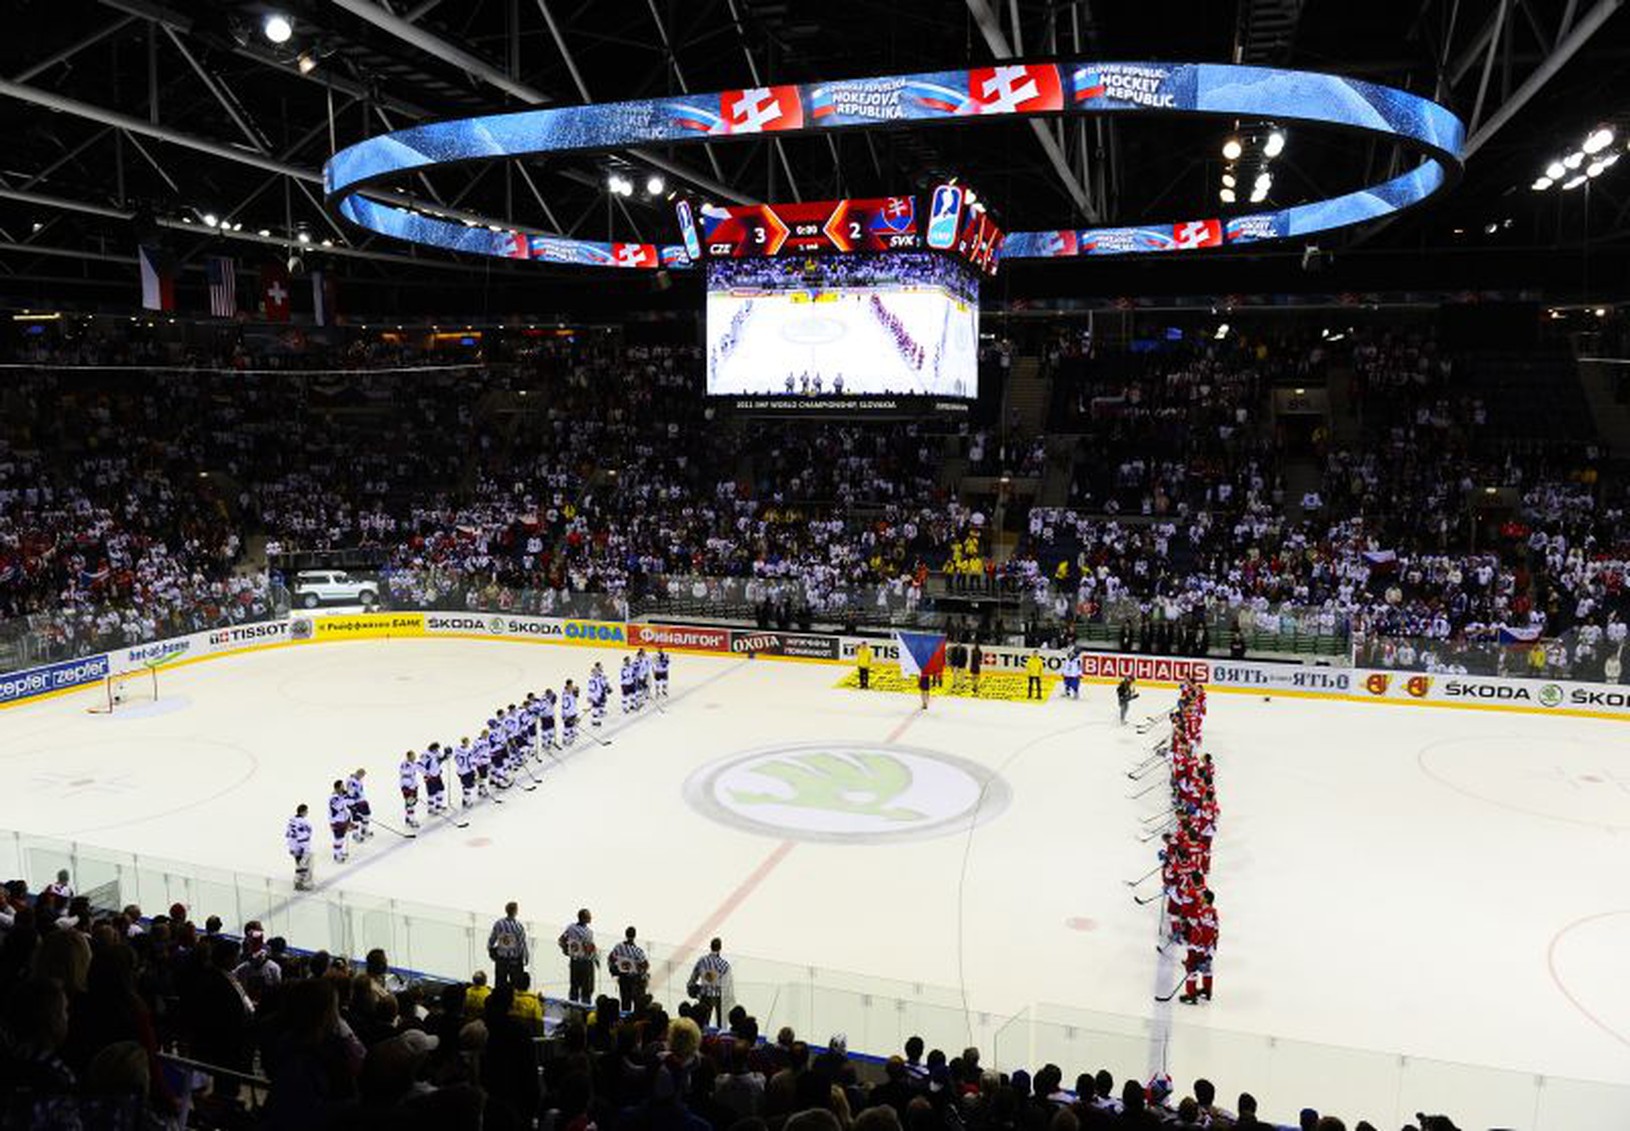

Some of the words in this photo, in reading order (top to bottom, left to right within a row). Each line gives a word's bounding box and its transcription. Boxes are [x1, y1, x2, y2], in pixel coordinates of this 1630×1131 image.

[1100, 74, 1160, 92] HOCKEY
[754, 228, 766, 243] 3
[849, 222, 862, 239] 2
[709, 243, 732, 254] CZE
[890, 234, 915, 247] SVK
[231, 623, 289, 641] TISSOT
[870, 645, 900, 659] TIS
[1084, 658, 1208, 682] BAUHAUS
[1571, 688, 1630, 706] ŠKO
